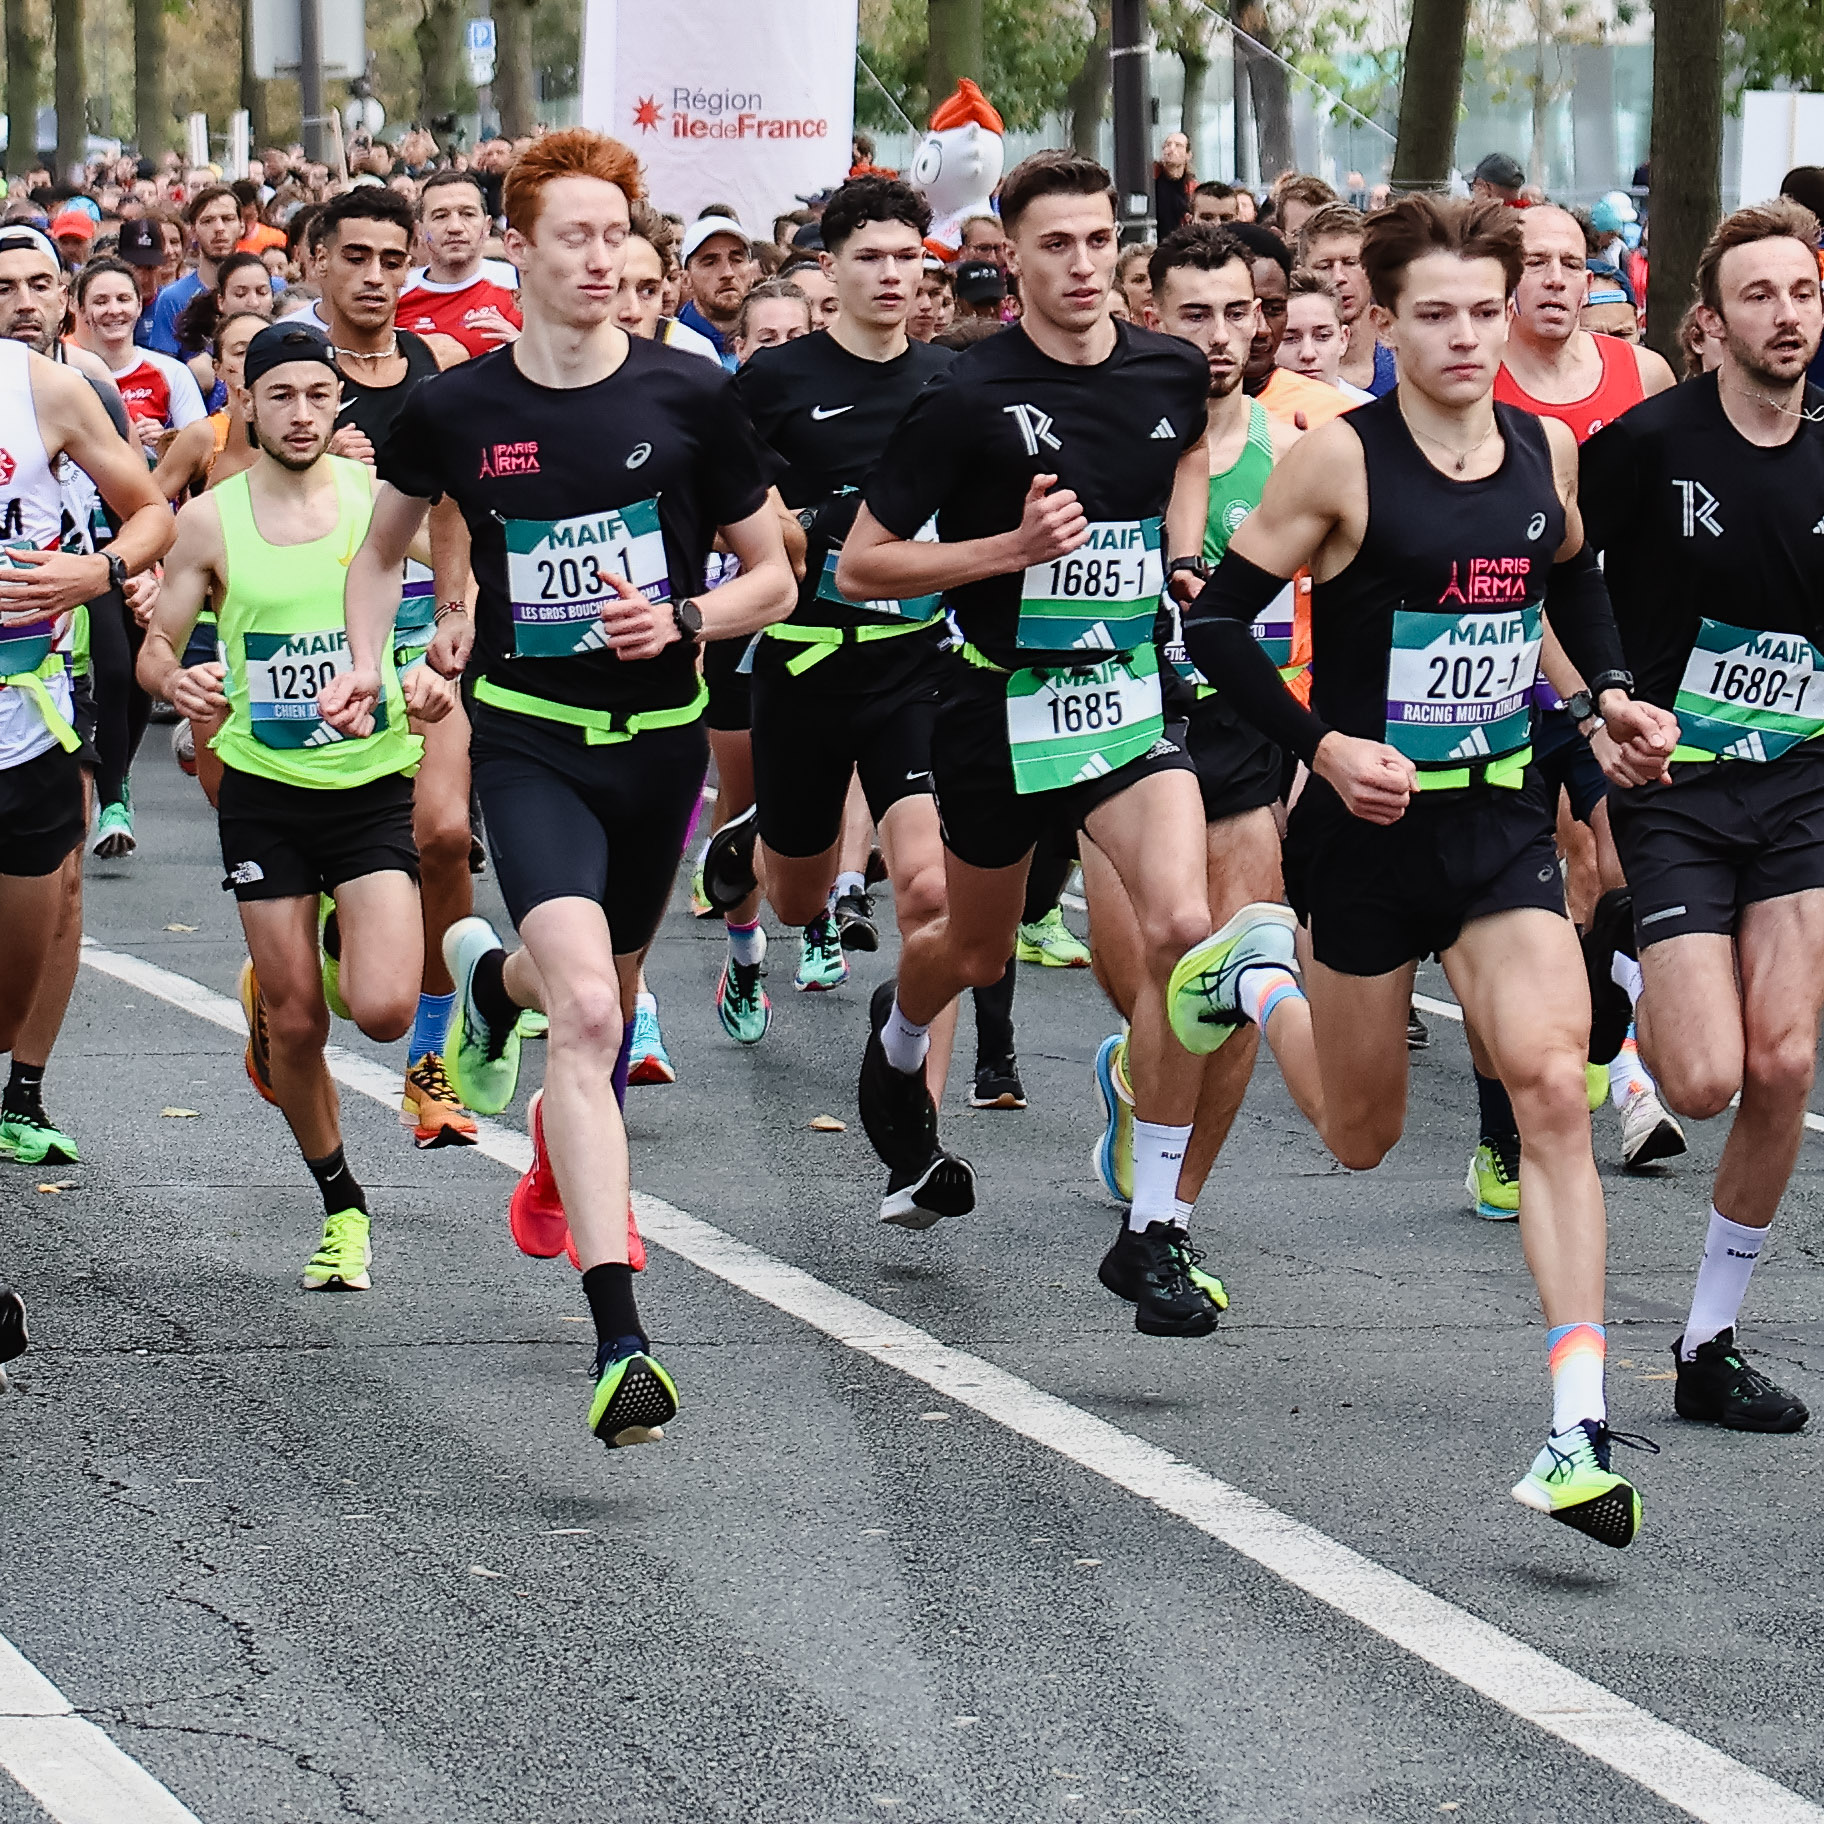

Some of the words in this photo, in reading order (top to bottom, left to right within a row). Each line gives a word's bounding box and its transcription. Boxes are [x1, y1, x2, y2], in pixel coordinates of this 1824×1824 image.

[673, 87, 763, 115] Région
[498, 441, 539, 456] PARIS
[499, 455, 541, 472] RMA
[548, 517, 623, 551] MAIF
[1050, 558, 1145, 598] 1685-1
[1475, 558, 1531, 575] PARIS
[1474, 576, 1526, 597] RMA
[521, 606, 538, 621] LES
[539, 604, 566, 620] GROS
[286, 631, 348, 657] MAIF
[1449, 619, 1525, 646] MAIF
[1745, 638, 1811, 665] MAIF
[1427, 652, 1521, 699] 202-1
[1709, 660, 1812, 712] 1680-1
[274, 704, 306, 718] CHIEN
[1048, 690, 1122, 734] 1685
[1403, 703, 1452, 723] RACING
[1456, 704, 1492, 722] MULTI
[1493, 692, 1524, 719] ATHLON
[1146, 744, 1181, 760] adidas
